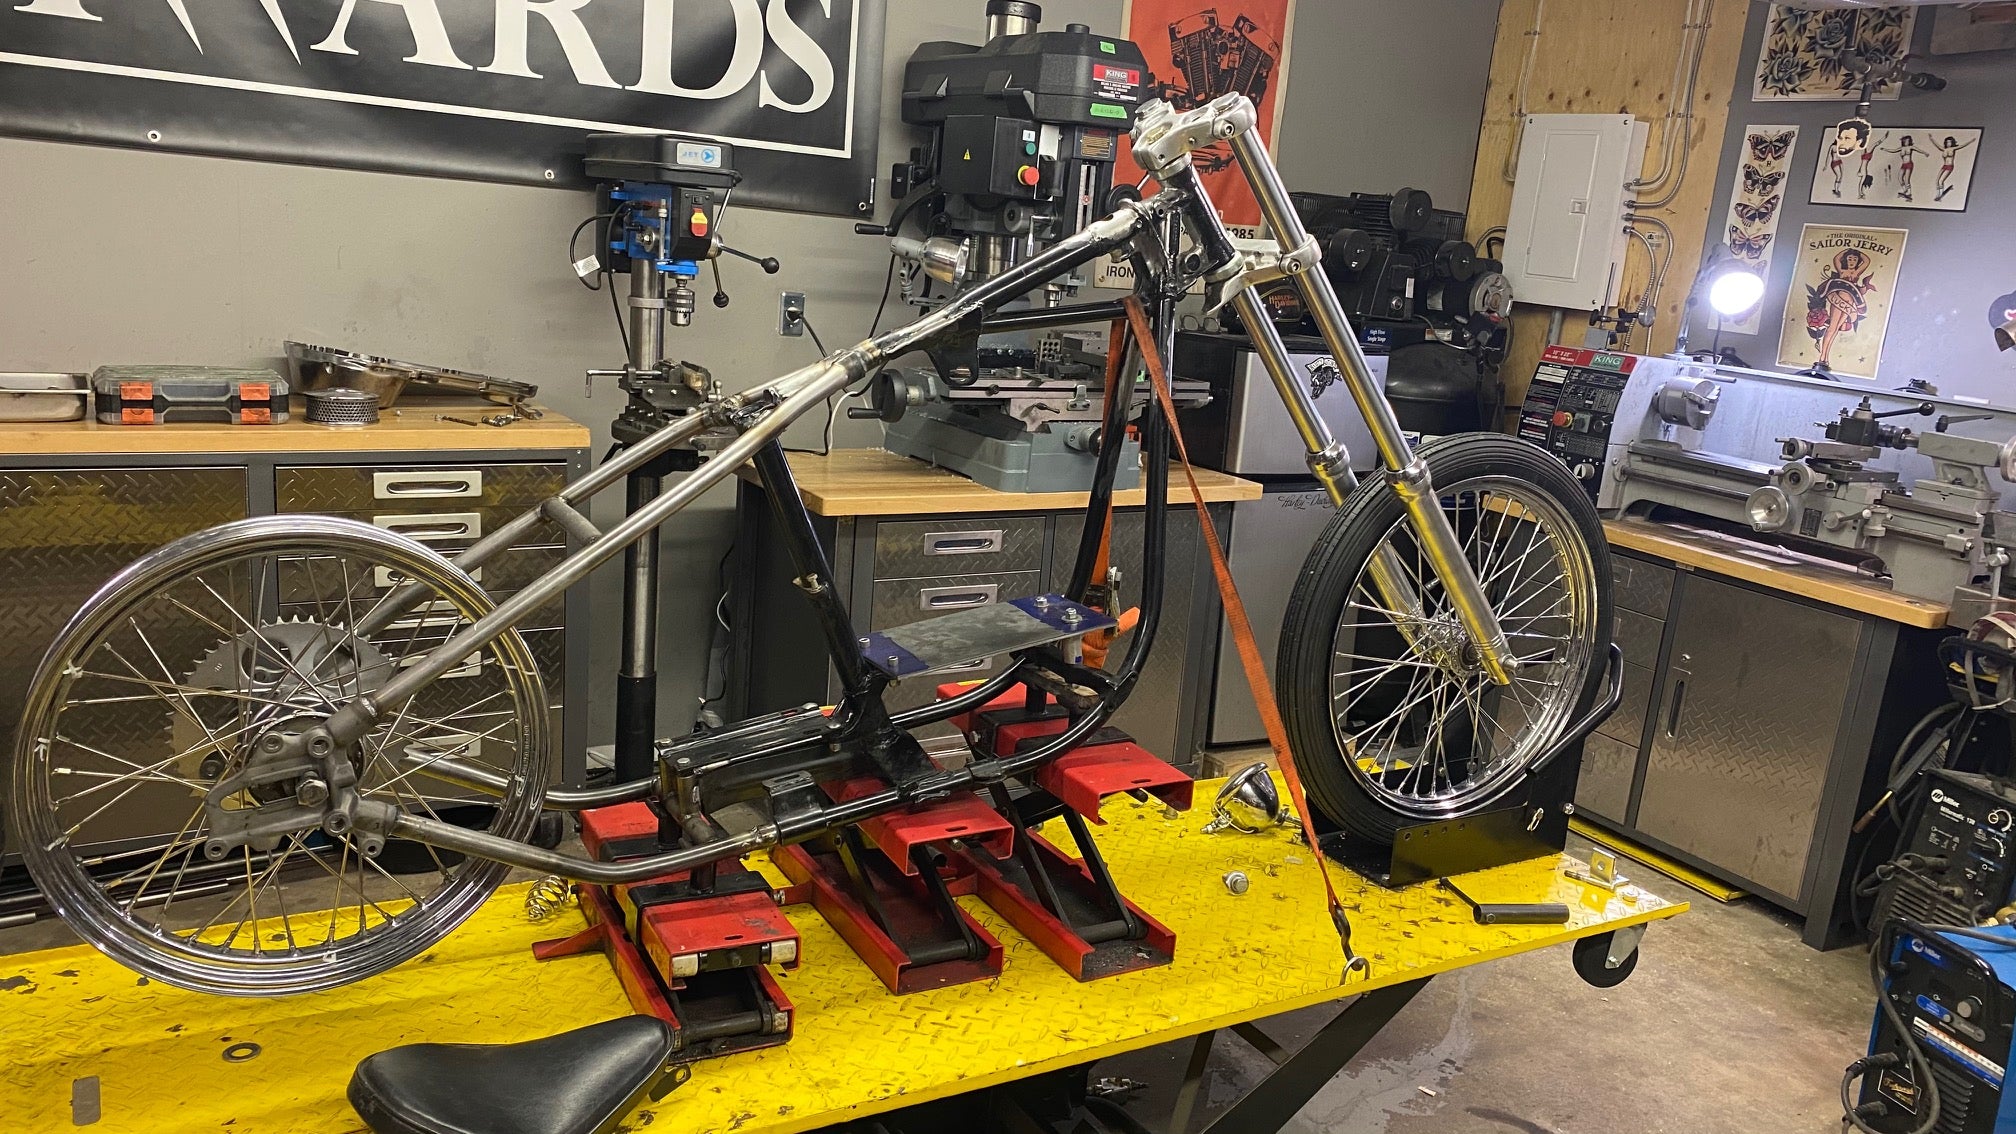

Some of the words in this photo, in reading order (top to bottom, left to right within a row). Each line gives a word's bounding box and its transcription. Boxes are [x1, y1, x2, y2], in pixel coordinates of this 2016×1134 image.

[1106, 70, 1127, 79] KING
[1226, 227, 1254, 239] 985
[1844, 233, 1874, 242] ORIGINAL
[1809, 239, 1851, 251] SAILOR
[1853, 240, 1894, 256] JERRY
[1830, 295, 1856, 314] LUCKY
[1594, 354, 1621, 365] KING
